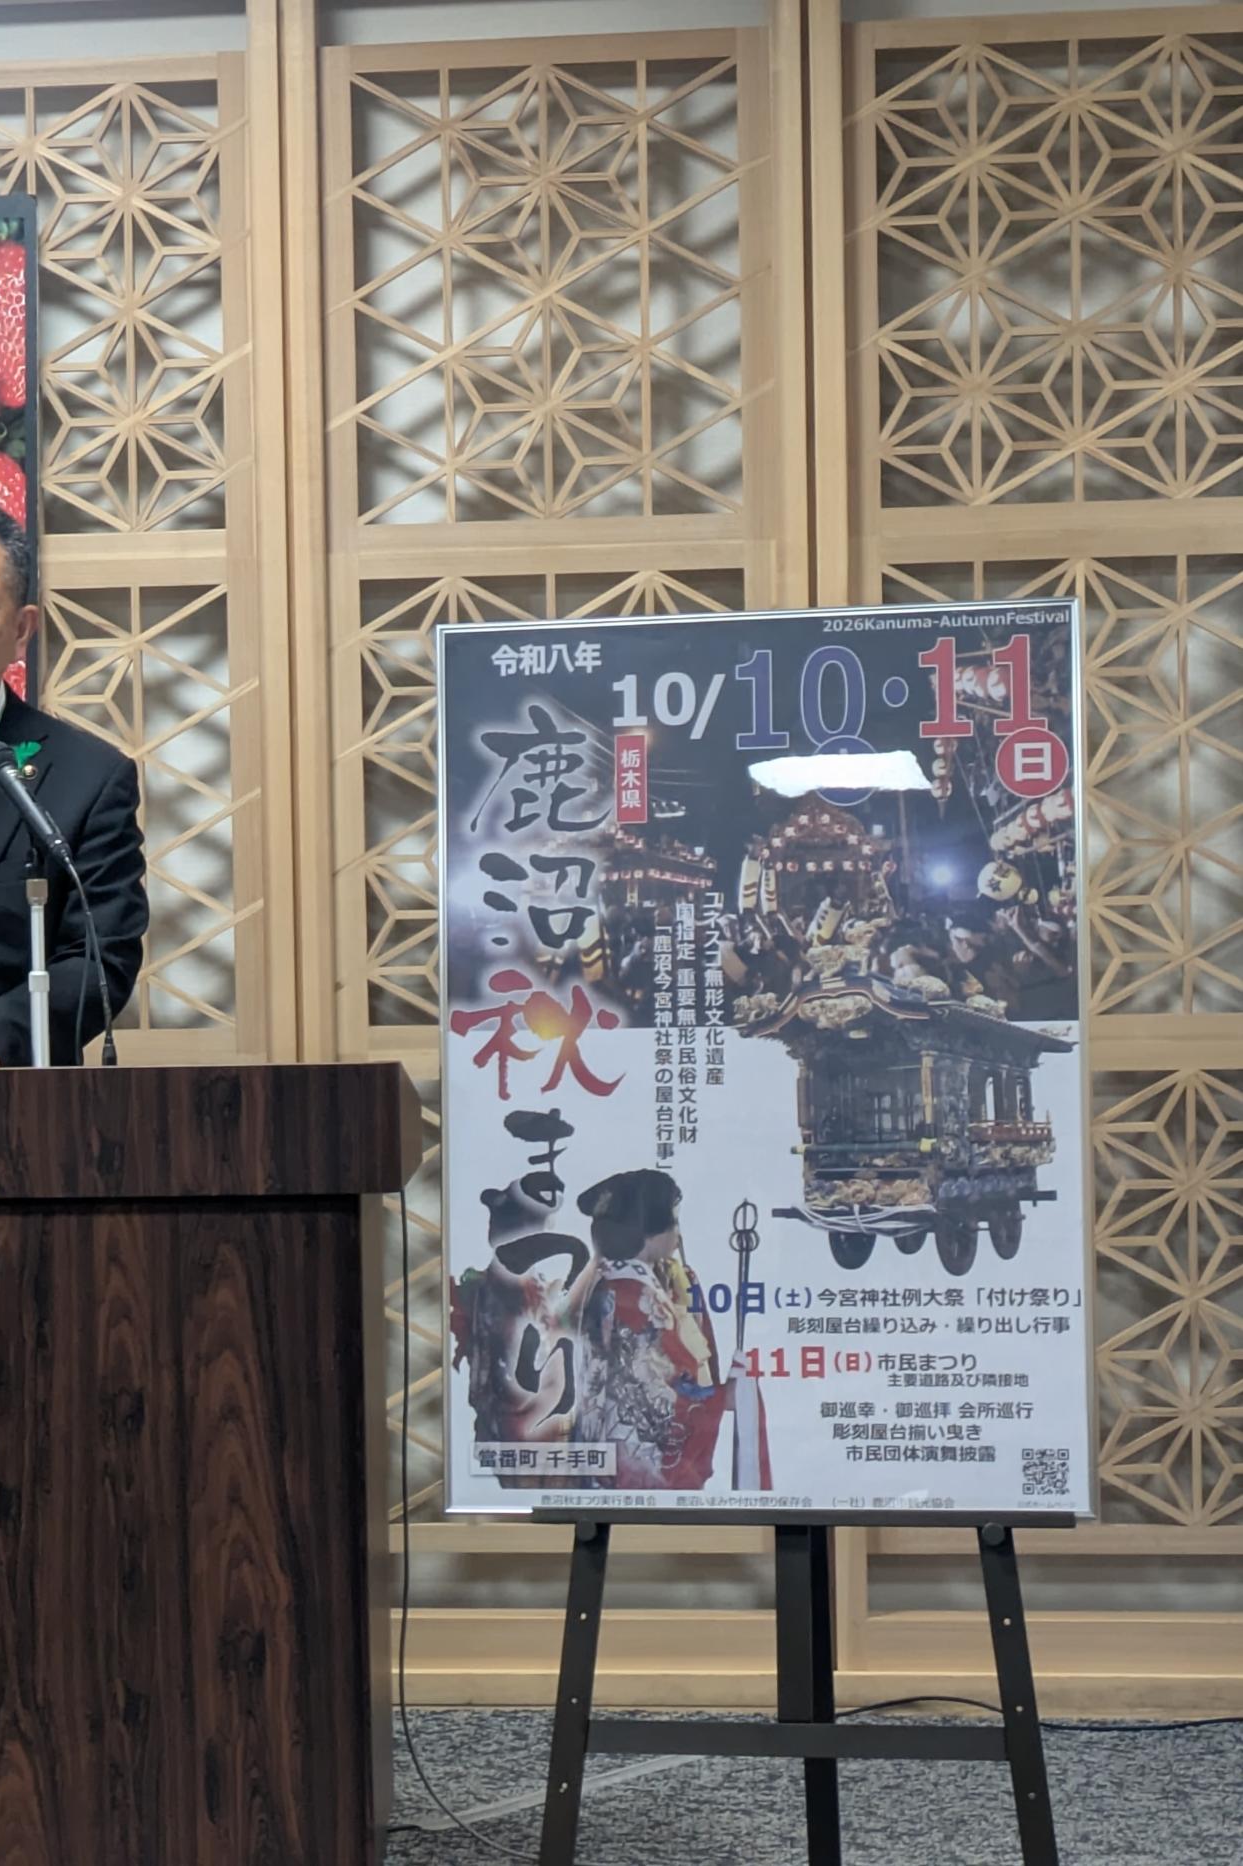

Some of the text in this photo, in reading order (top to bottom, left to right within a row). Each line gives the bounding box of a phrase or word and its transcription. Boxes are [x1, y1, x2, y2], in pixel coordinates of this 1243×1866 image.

[823, 610, 1070, 633] 2026Kanuma-AutumnFestival
[491, 641, 602, 677] 令和八年
[1014, 742, 1052, 781] 日
[621, 749, 641, 808] 栃木県
[703, 892, 725, 1085] ユネスコ無形文化遺産
[654, 925, 674, 1170] 「鹿沼今宮神社祭の屋台行事」
[677, 968, 698, 1144] 重要無形民俗文化財
[450, 704, 627, 1434] 鹿沼秋まつり
[817, 1287, 1083, 1309] 今宮神社例大祭「付け祭り」
[787, 1317, 1071, 1335] 彫刻屋台繰り込み・繰り出し行事
[877, 1353, 978, 1373] 市民まつり
[887, 1373, 1029, 1389] 主要道路及び隣接地
[820, 1402, 1033, 1419] 御巡幸・御巡拝 会所巡行
[832, 1423, 982, 1441] 彫刻屋台揃い曳き
[546, 1449, 607, 1469] 千手町
[846, 1446, 996, 1463] 市民団体演舞披露
